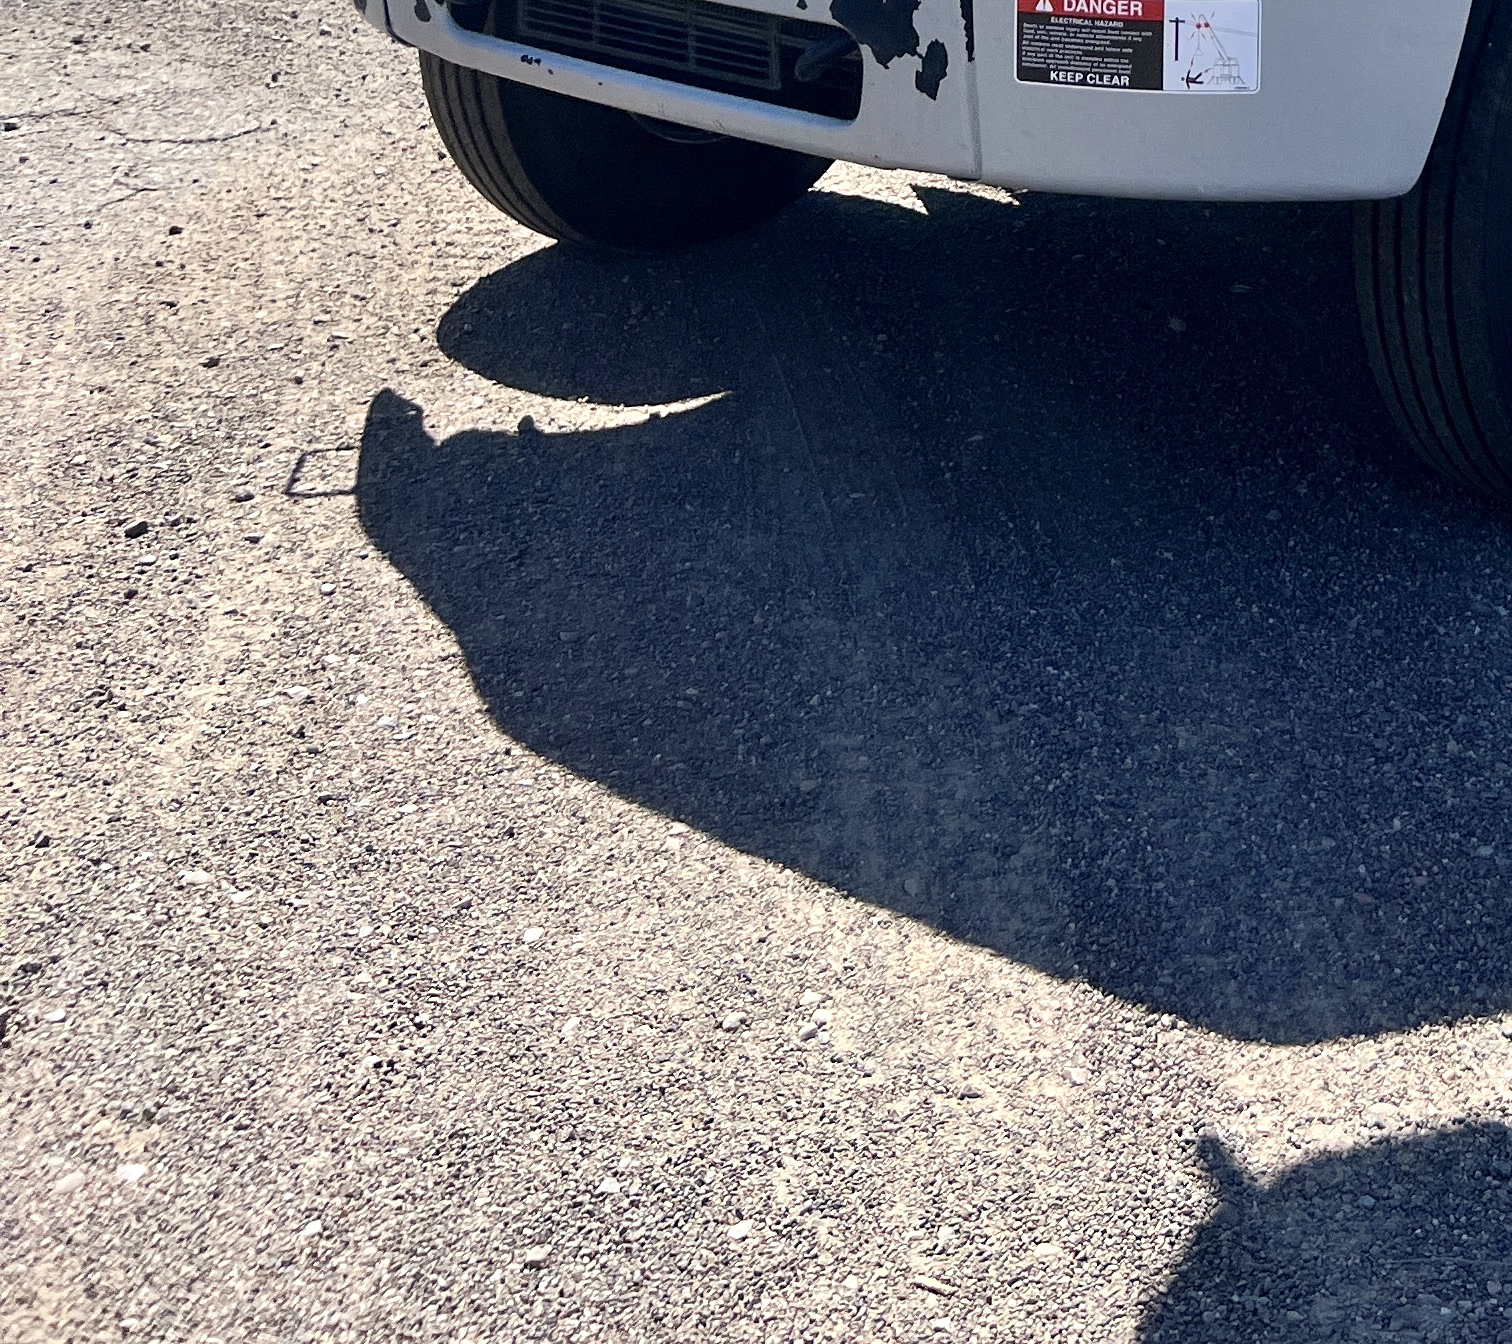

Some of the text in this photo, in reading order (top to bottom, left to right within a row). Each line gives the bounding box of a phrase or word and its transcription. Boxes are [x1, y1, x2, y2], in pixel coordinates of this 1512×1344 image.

[1050, 16, 1124, 28] ELECTRICAL HAZARD
[1049, 70, 1130, 87] KEEP CLEAR
